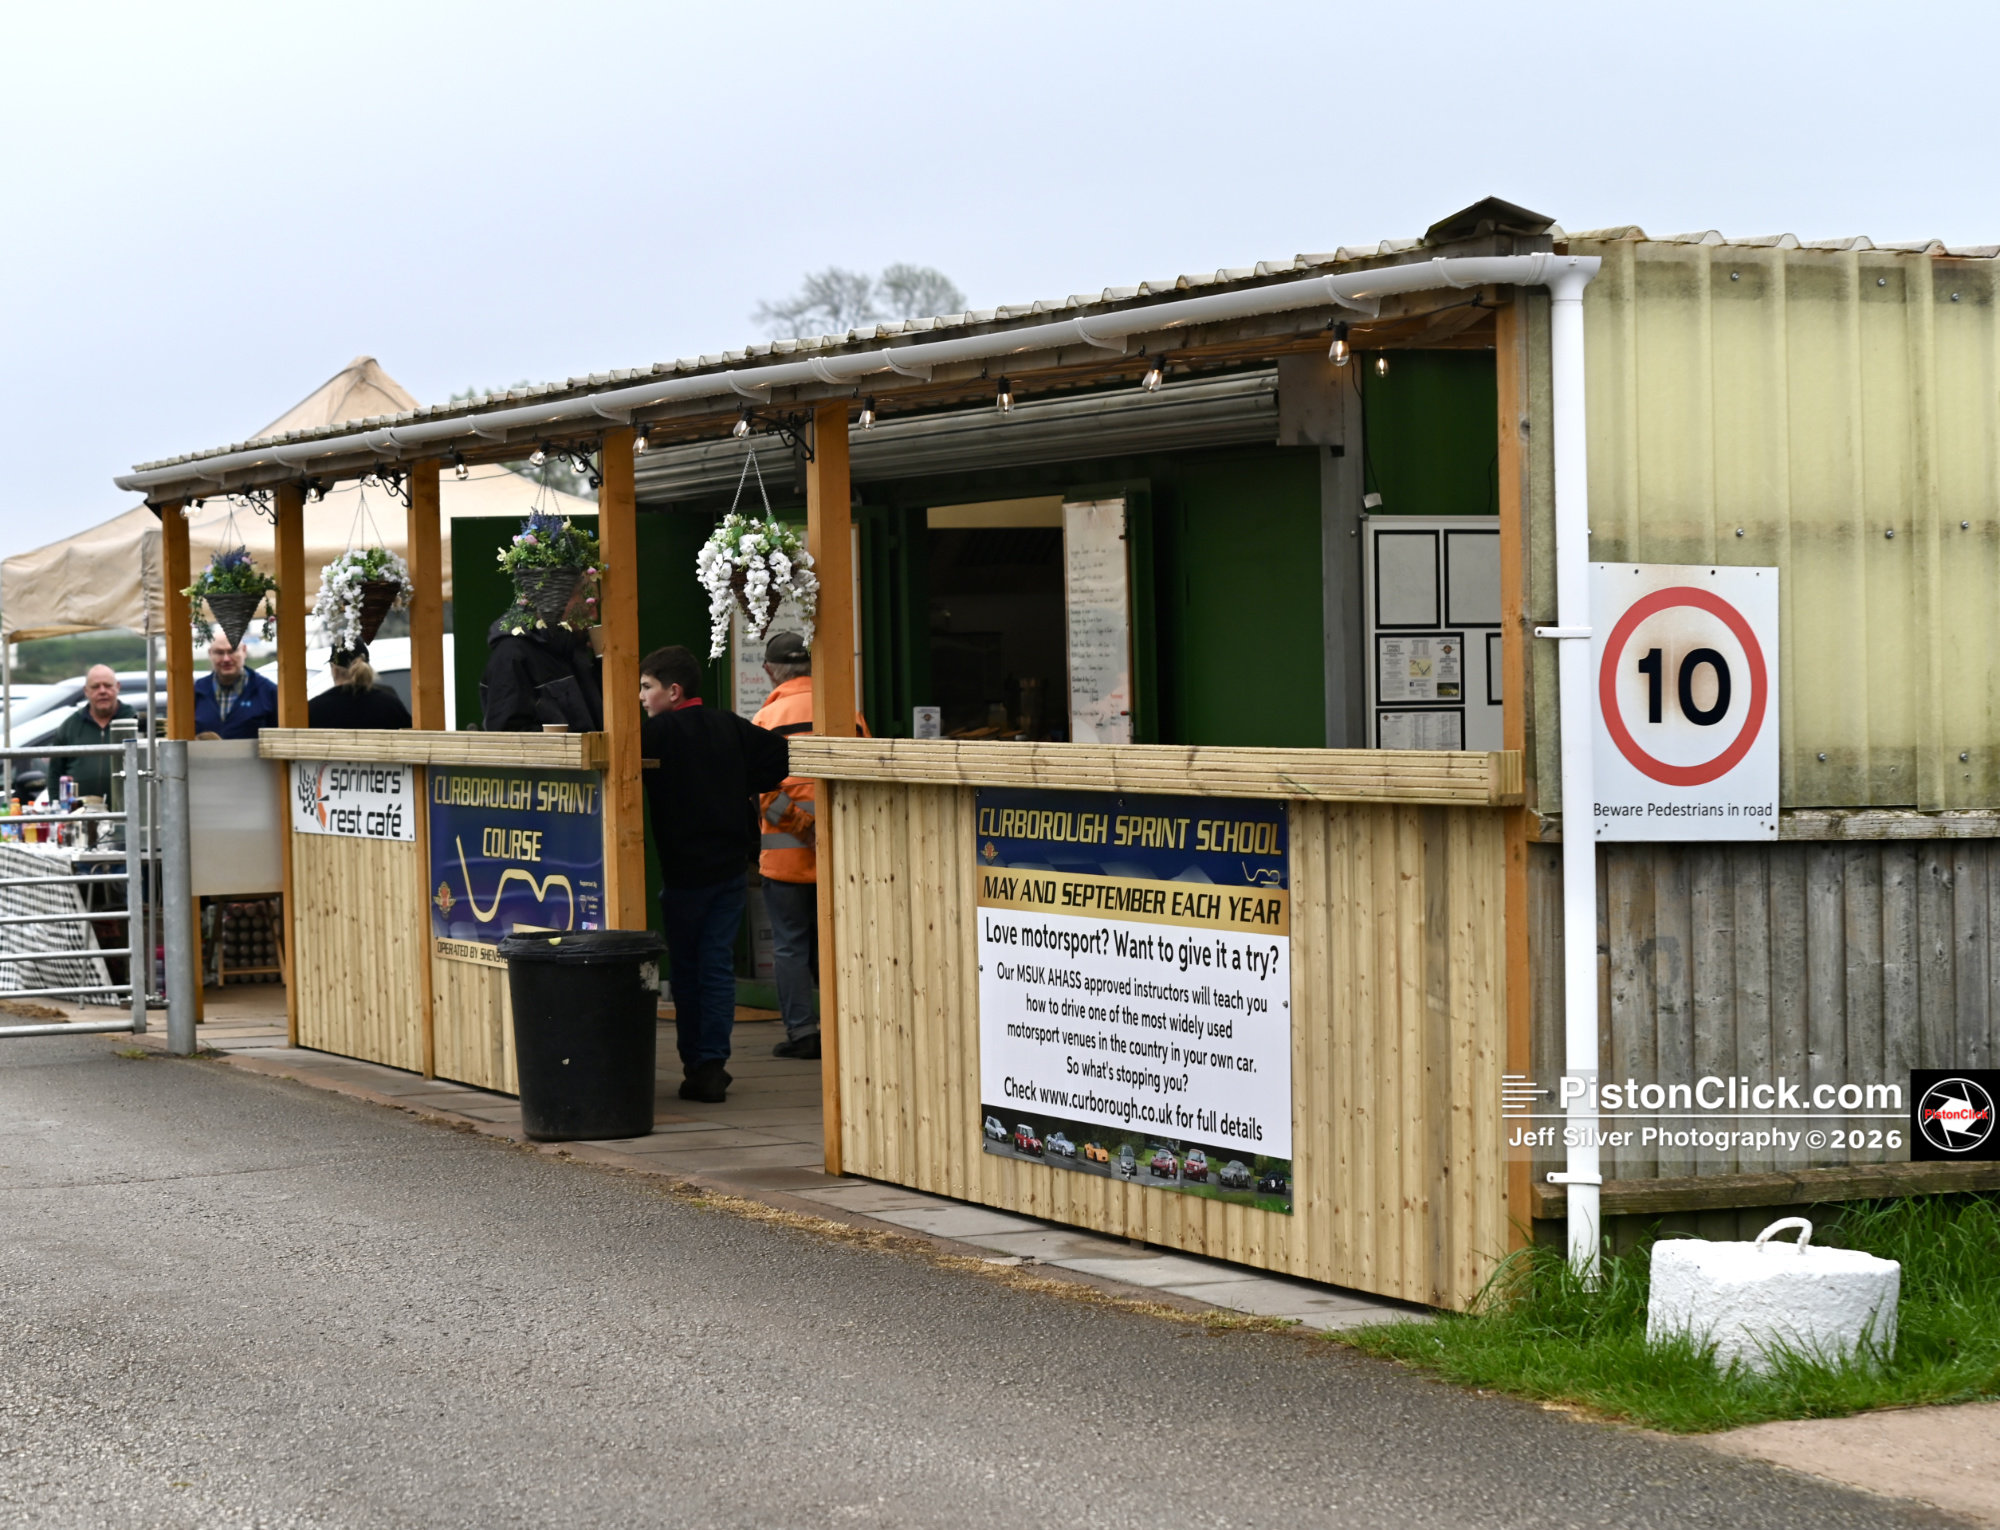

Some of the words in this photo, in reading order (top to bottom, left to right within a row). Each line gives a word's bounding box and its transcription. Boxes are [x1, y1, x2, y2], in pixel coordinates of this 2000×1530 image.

[1638, 648, 1731, 726] 10
[330, 763, 405, 799] sprinters'
[434, 775, 532, 811] CURBOROUGH
[536, 781, 598, 814] SPRINT
[330, 804, 361, 834] rest
[367, 803, 402, 838] café
[978, 807, 1109, 844] CURBOROUGH
[1113, 815, 1191, 849] SPRINT
[1195, 819, 1283, 855] SCHOOL
[1593, 803, 1643, 817] Beware
[1648, 803, 1724, 817] Pedestrians
[1728, 803, 1740, 817] in
[1743, 803, 1772, 817] road
[482, 827, 543, 862] COURSE
[983, 876, 1019, 901] MAY
[1020, 879, 1056, 905] AND
[1061, 882, 1167, 915] SEPTEMBER
[1171, 891, 1221, 920] EACH
[1228, 895, 1281, 925] YEAR
[437, 941, 468, 957] OPERATED
[470, 946, 479, 959] BY
[986, 916, 1018, 946] Love
[1021, 923, 1110, 960] motorsport?
[1113, 929, 1154, 961] Want
[1157, 937, 1174, 963] to
[1178, 936, 1212, 972] give
[1215, 939, 1228, 969] it
[1231, 949, 1241, 970] a
[1246, 944, 1280, 981] try?
[997, 963, 1014, 981] Our
[1016, 964, 1046, 986] MSUK
[1048, 968, 1082, 990] AHASS
[1084, 974, 1131, 999] approved
[1134, 978, 1189, 1003] instructors
[1192, 986, 1211, 1006] will
[1213, 989, 1244, 1011] teach
[1246, 997, 1268, 1016] you
[1026, 993, 1046, 1014] how
[1048, 998, 1059, 1015] to
[1061, 998, 1086, 1019] drive
[1088, 1006, 1107, 1022] one
[1109, 1005, 1120, 1024] of
[1121, 1006, 1139, 1026] the
[1141, 1011, 1167, 1030] most
[1169, 1012, 1204, 1039] widely
[1207, 1020, 1233, 1039] used
[1007, 1022, 1060, 1046] motorsport
[1062, 1031, 1096, 1049] venues
[1098, 1032, 1108, 1051] in
[1110, 1034, 1127, 1054] the
[1129, 1039, 1168, 1064] country
[1171, 1042, 1181, 1061] in
[1183, 1048, 1208, 1067] your
[1210, 1051, 1234, 1070] own
[1236, 1055, 1257, 1073] car.
[1066, 1057, 1079, 1075] So
[1081, 1060, 1114, 1080] what's
[1116, 1067, 1161, 1093] stopping
[1163, 1073, 1189, 1095] you?
[1004, 1076, 1037, 1102] Check
[1039, 1087, 1173, 1125] www.curborough.co.uk
[1175, 1105, 1194, 1129] for
[1196, 1109, 1217, 1133] full
[1220, 1114, 1263, 1141] details
